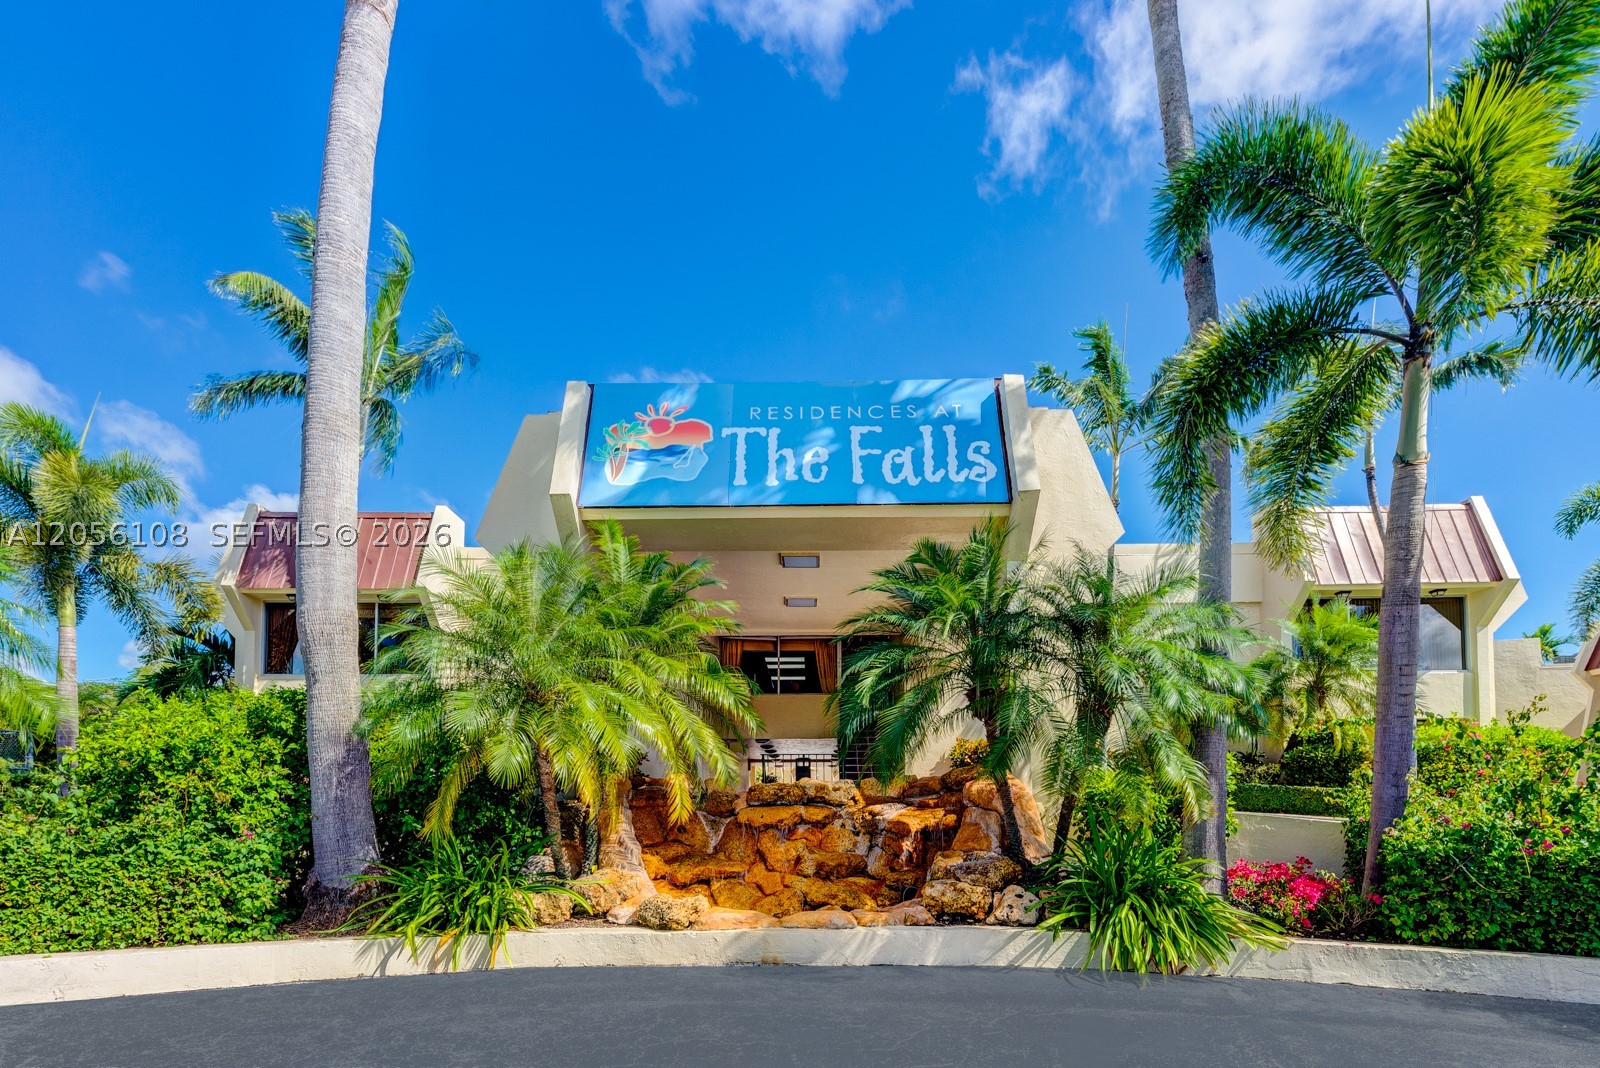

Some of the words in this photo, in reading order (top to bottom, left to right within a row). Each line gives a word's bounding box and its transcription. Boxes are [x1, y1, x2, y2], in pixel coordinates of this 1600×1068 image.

[749, 404, 916, 420] RESIDENCES
[934, 404, 962, 418] AT
[721, 426, 829, 486] The
[850, 424, 997, 486] Falls
